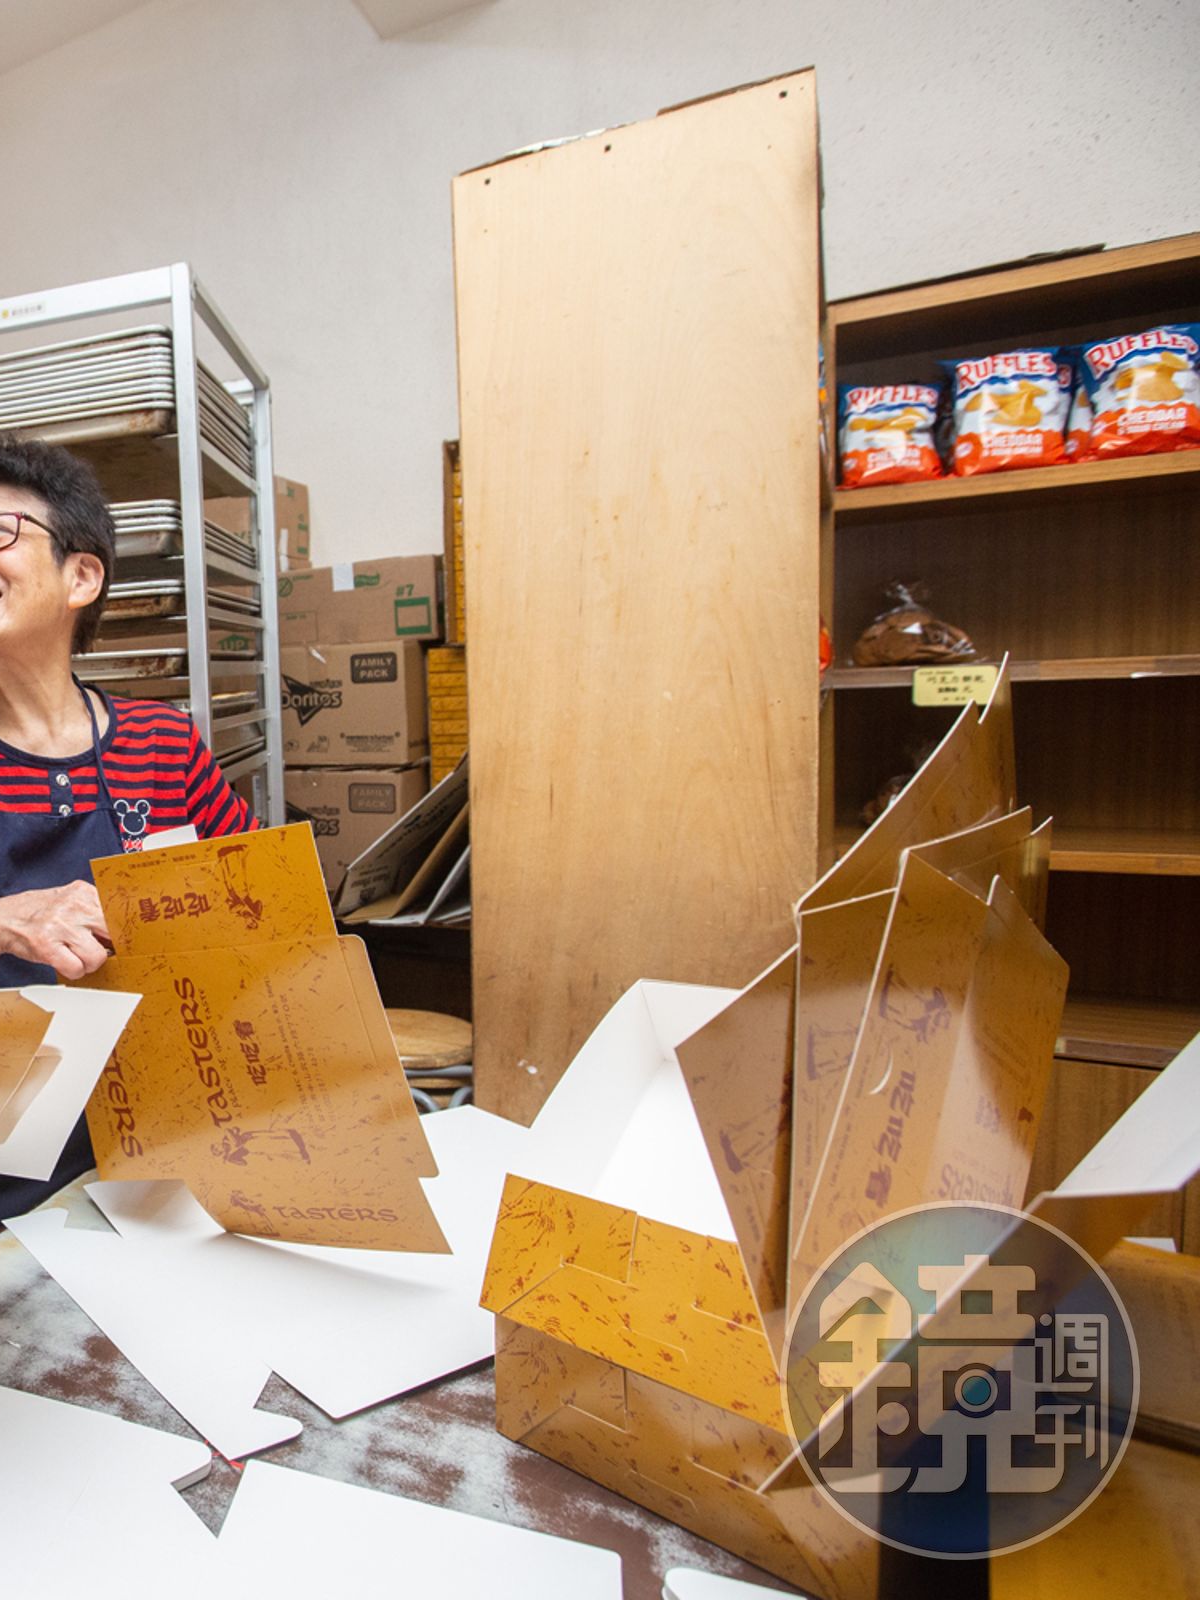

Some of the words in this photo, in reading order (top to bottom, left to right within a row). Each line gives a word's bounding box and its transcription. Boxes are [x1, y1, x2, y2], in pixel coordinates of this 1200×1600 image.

[956, 352, 1056, 391] RUFFLES
[1085, 331, 1198, 379] RUFFLES
[847, 386, 938, 413] RUFFLES
[354, 658, 392, 667] FAMILY
[360, 669, 388, 678] PACK
[353, 787, 392, 797] FAMILY
[139, 892, 213, 923] 吃吃看
[174, 976, 233, 1129] TASTERS
[233, 1020, 268, 1087] 吃吃看
[104, 1046, 144, 1158] TERS
[864, 1069, 916, 1208] 吃吃看
[272, 1204, 398, 1224] TASTERS
